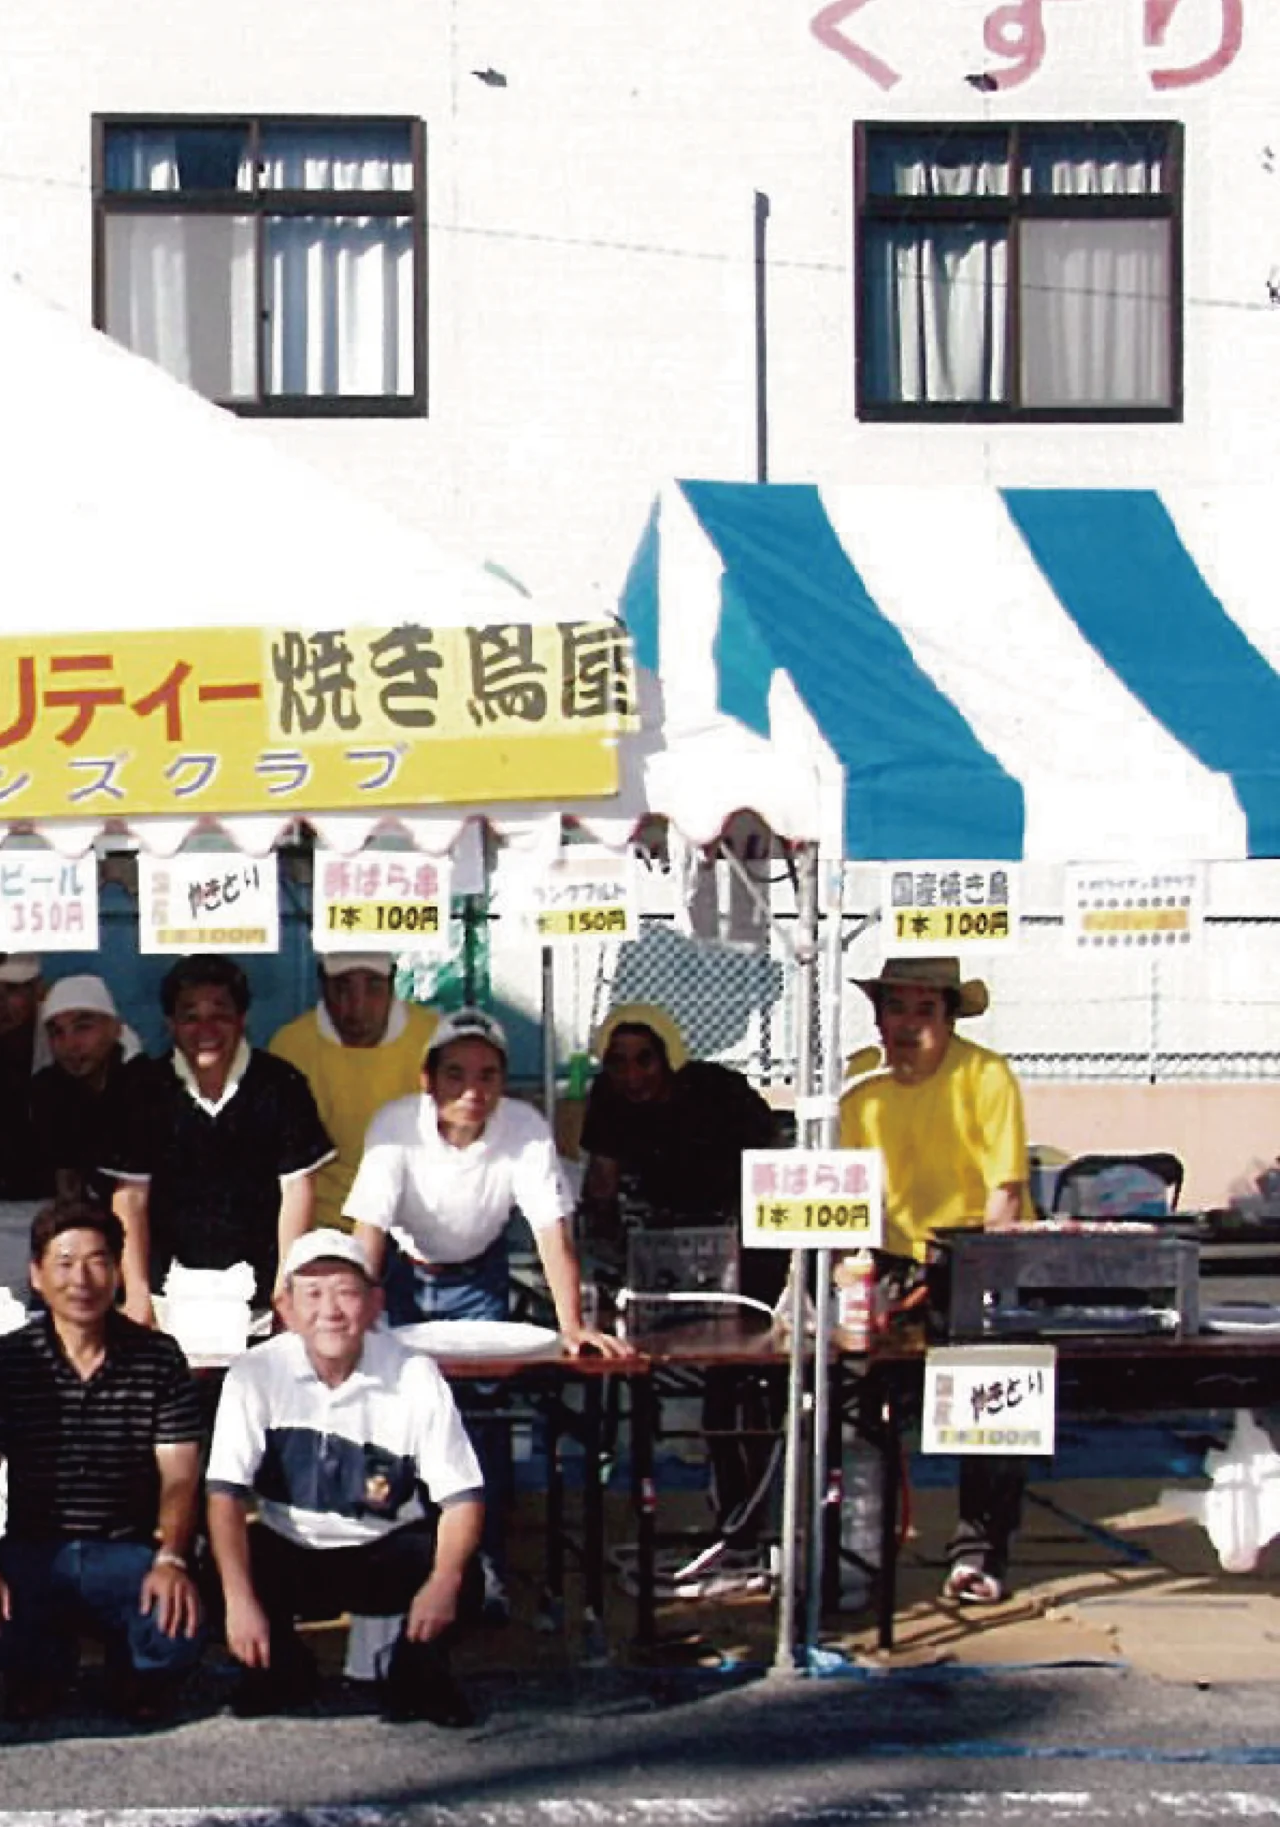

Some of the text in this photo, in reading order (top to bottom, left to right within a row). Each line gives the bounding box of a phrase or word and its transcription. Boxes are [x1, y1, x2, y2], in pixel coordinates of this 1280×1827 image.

[810, 0, 1243, 91] くすり
[272, 620, 634, 736] 焼き鳥屋
[188, 865, 260, 920] やきとり
[891, 870, 1008, 907] 国産焼き鳥
[12, 901, 84, 932] 350円
[328, 906, 438, 933] 1本 100円
[567, 909, 627, 932] 150円
[896, 910, 1008, 938] 1本 100円
[756, 1203, 869, 1230] 1本 100円
[971, 1370, 1044, 1424] やきとり
